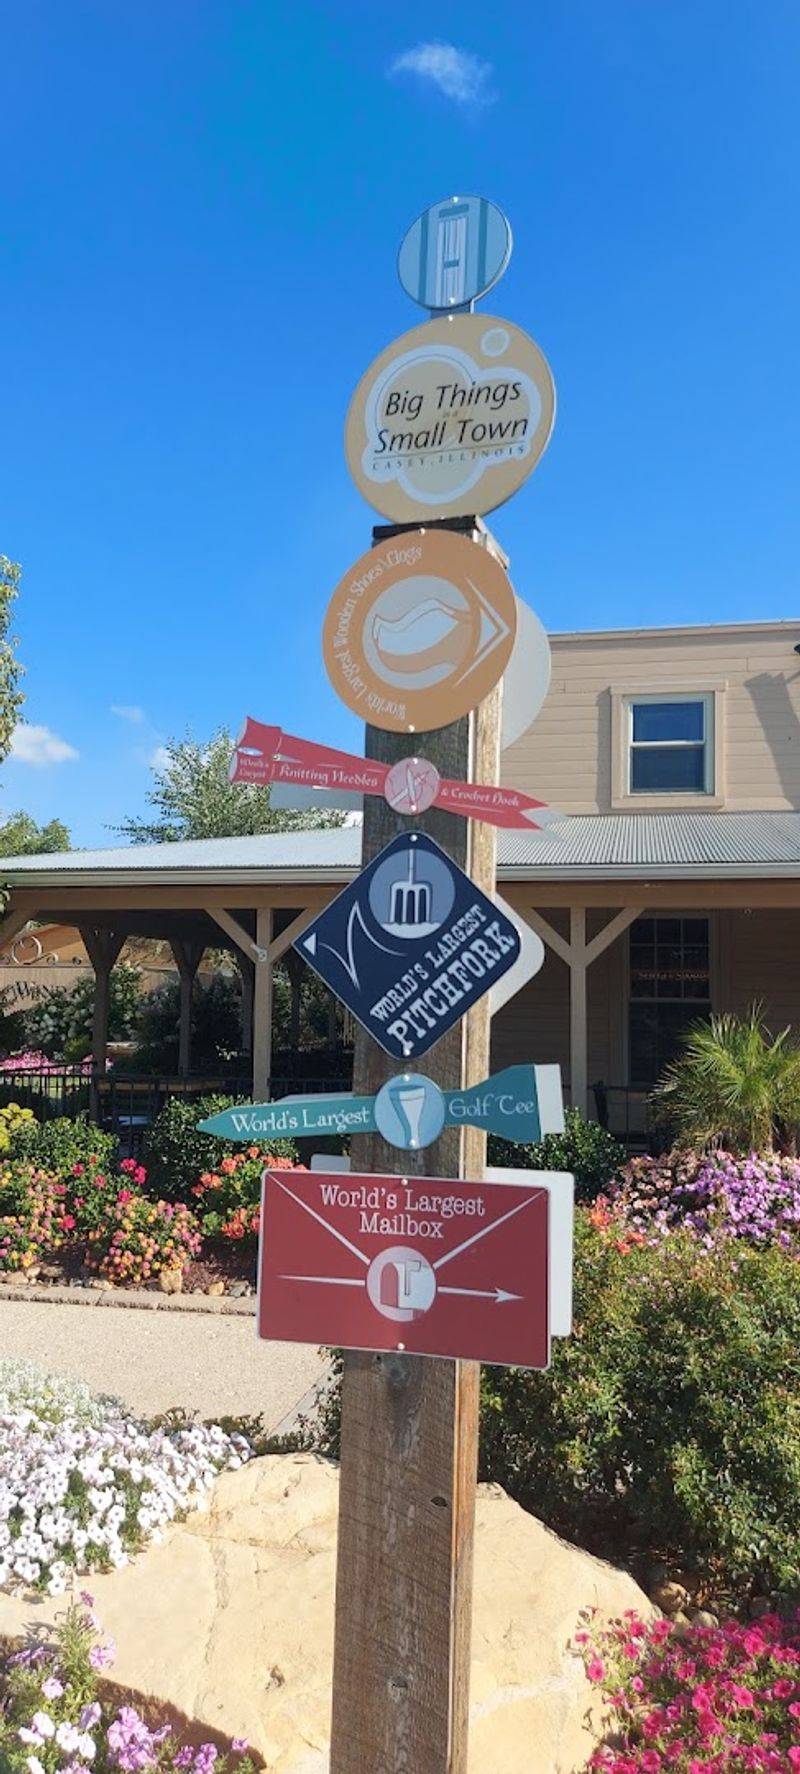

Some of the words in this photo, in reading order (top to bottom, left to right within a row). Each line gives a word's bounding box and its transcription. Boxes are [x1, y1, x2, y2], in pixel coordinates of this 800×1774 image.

[385, 390, 424, 421] Big
[437, 381, 522, 410] Things
[374, 422, 446, 453] Small
[458, 418, 529, 443] Town
[333, 600, 357, 648] Wooden
[279, 765, 329, 784] Knitting
[332, 770, 378, 788] Needles
[440, 788, 448, 796] &
[451, 788, 490, 802] Crochet
[492, 792, 520, 807] Hook
[370, 963, 429, 1021] WORLD'S
[424, 904, 487, 968] LARGEST
[386, 921, 515, 1052] PITCHFORK
[231, 1111, 299, 1133] World's
[302, 1107, 371, 1132] Largest
[449, 1094, 495, 1118] Golf
[499, 1095, 534, 1116] Tee
[319, 1184, 397, 1210] World's
[404, 1189, 486, 1217] Largest
[359, 1212, 444, 1239] Mailbox
